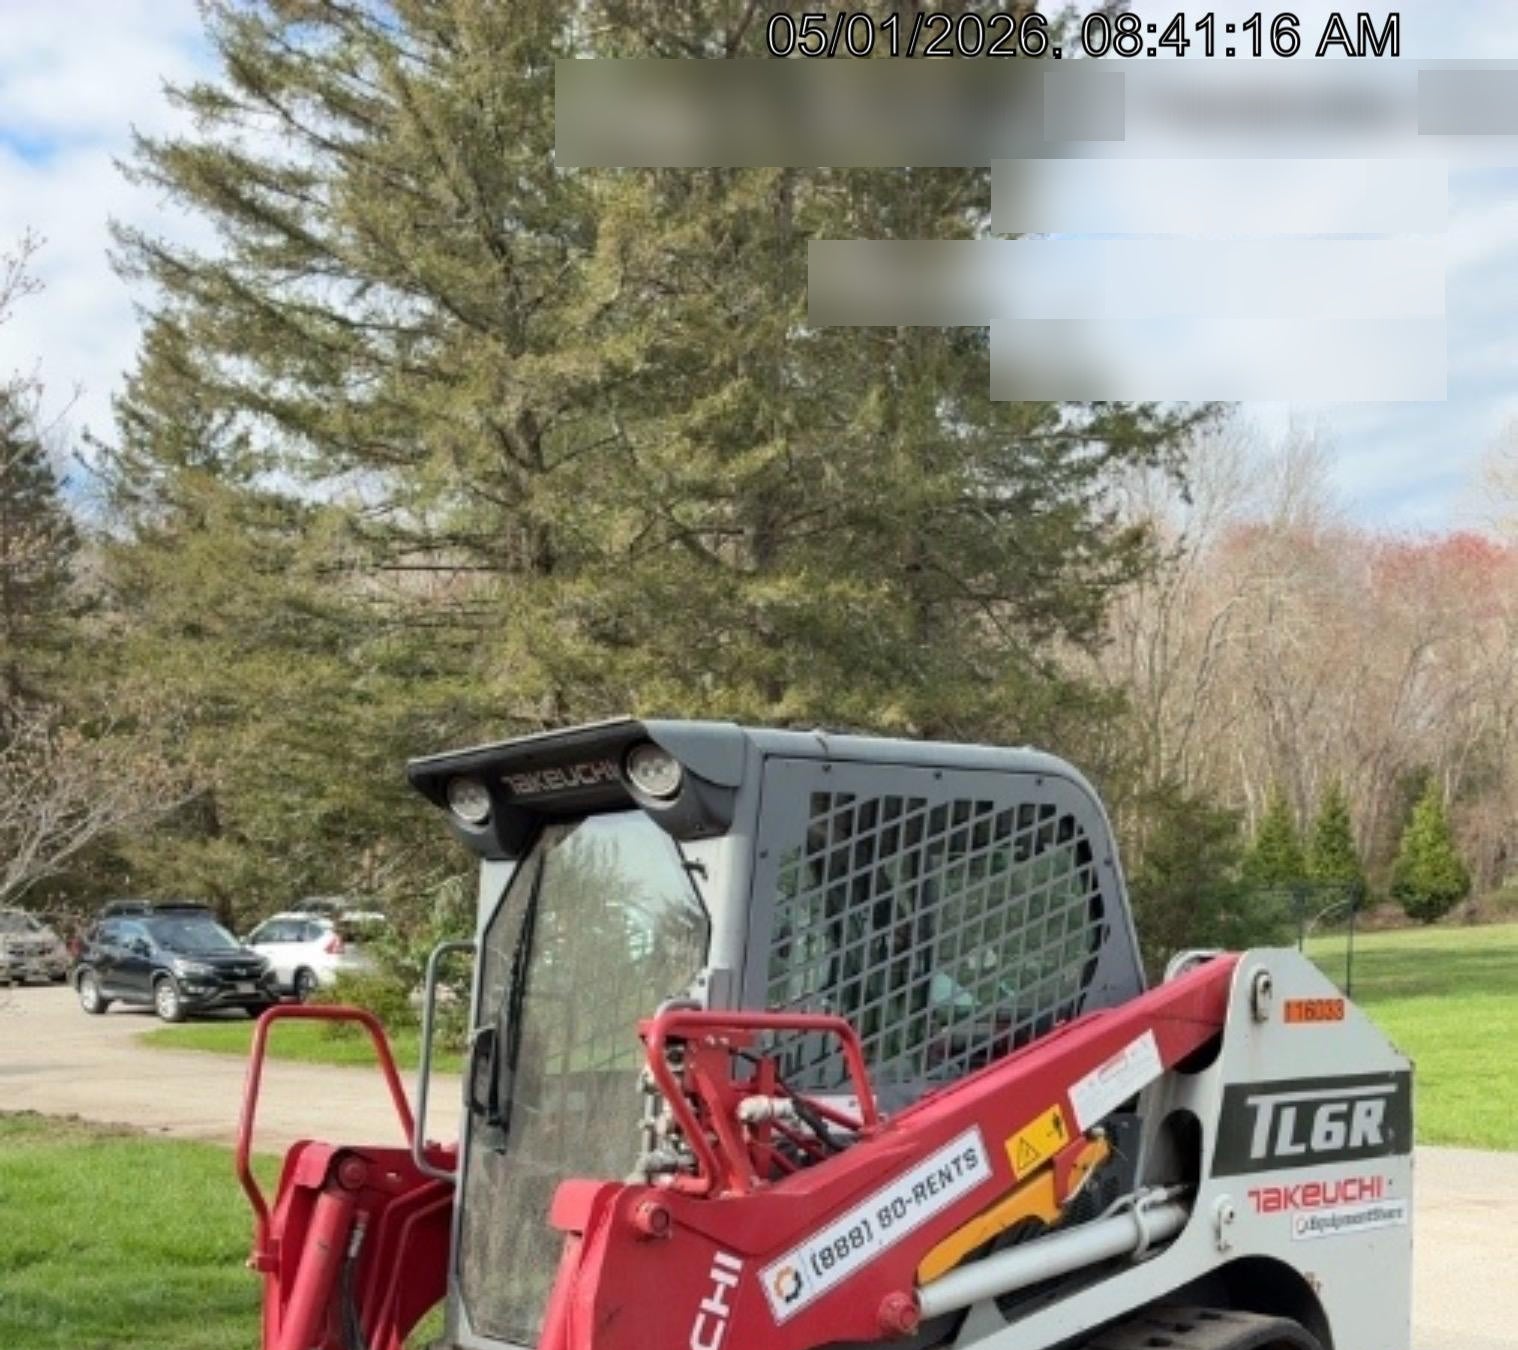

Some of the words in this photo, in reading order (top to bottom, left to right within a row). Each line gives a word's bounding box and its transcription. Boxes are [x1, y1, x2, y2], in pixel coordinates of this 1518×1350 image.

[1246, 1083, 1398, 1160] TL6R
[809, 1218, 875, 1277] (888)
[876, 1147, 979, 1230] 80-RENTS
[1247, 1174, 1384, 1214] TAKEUCHI
